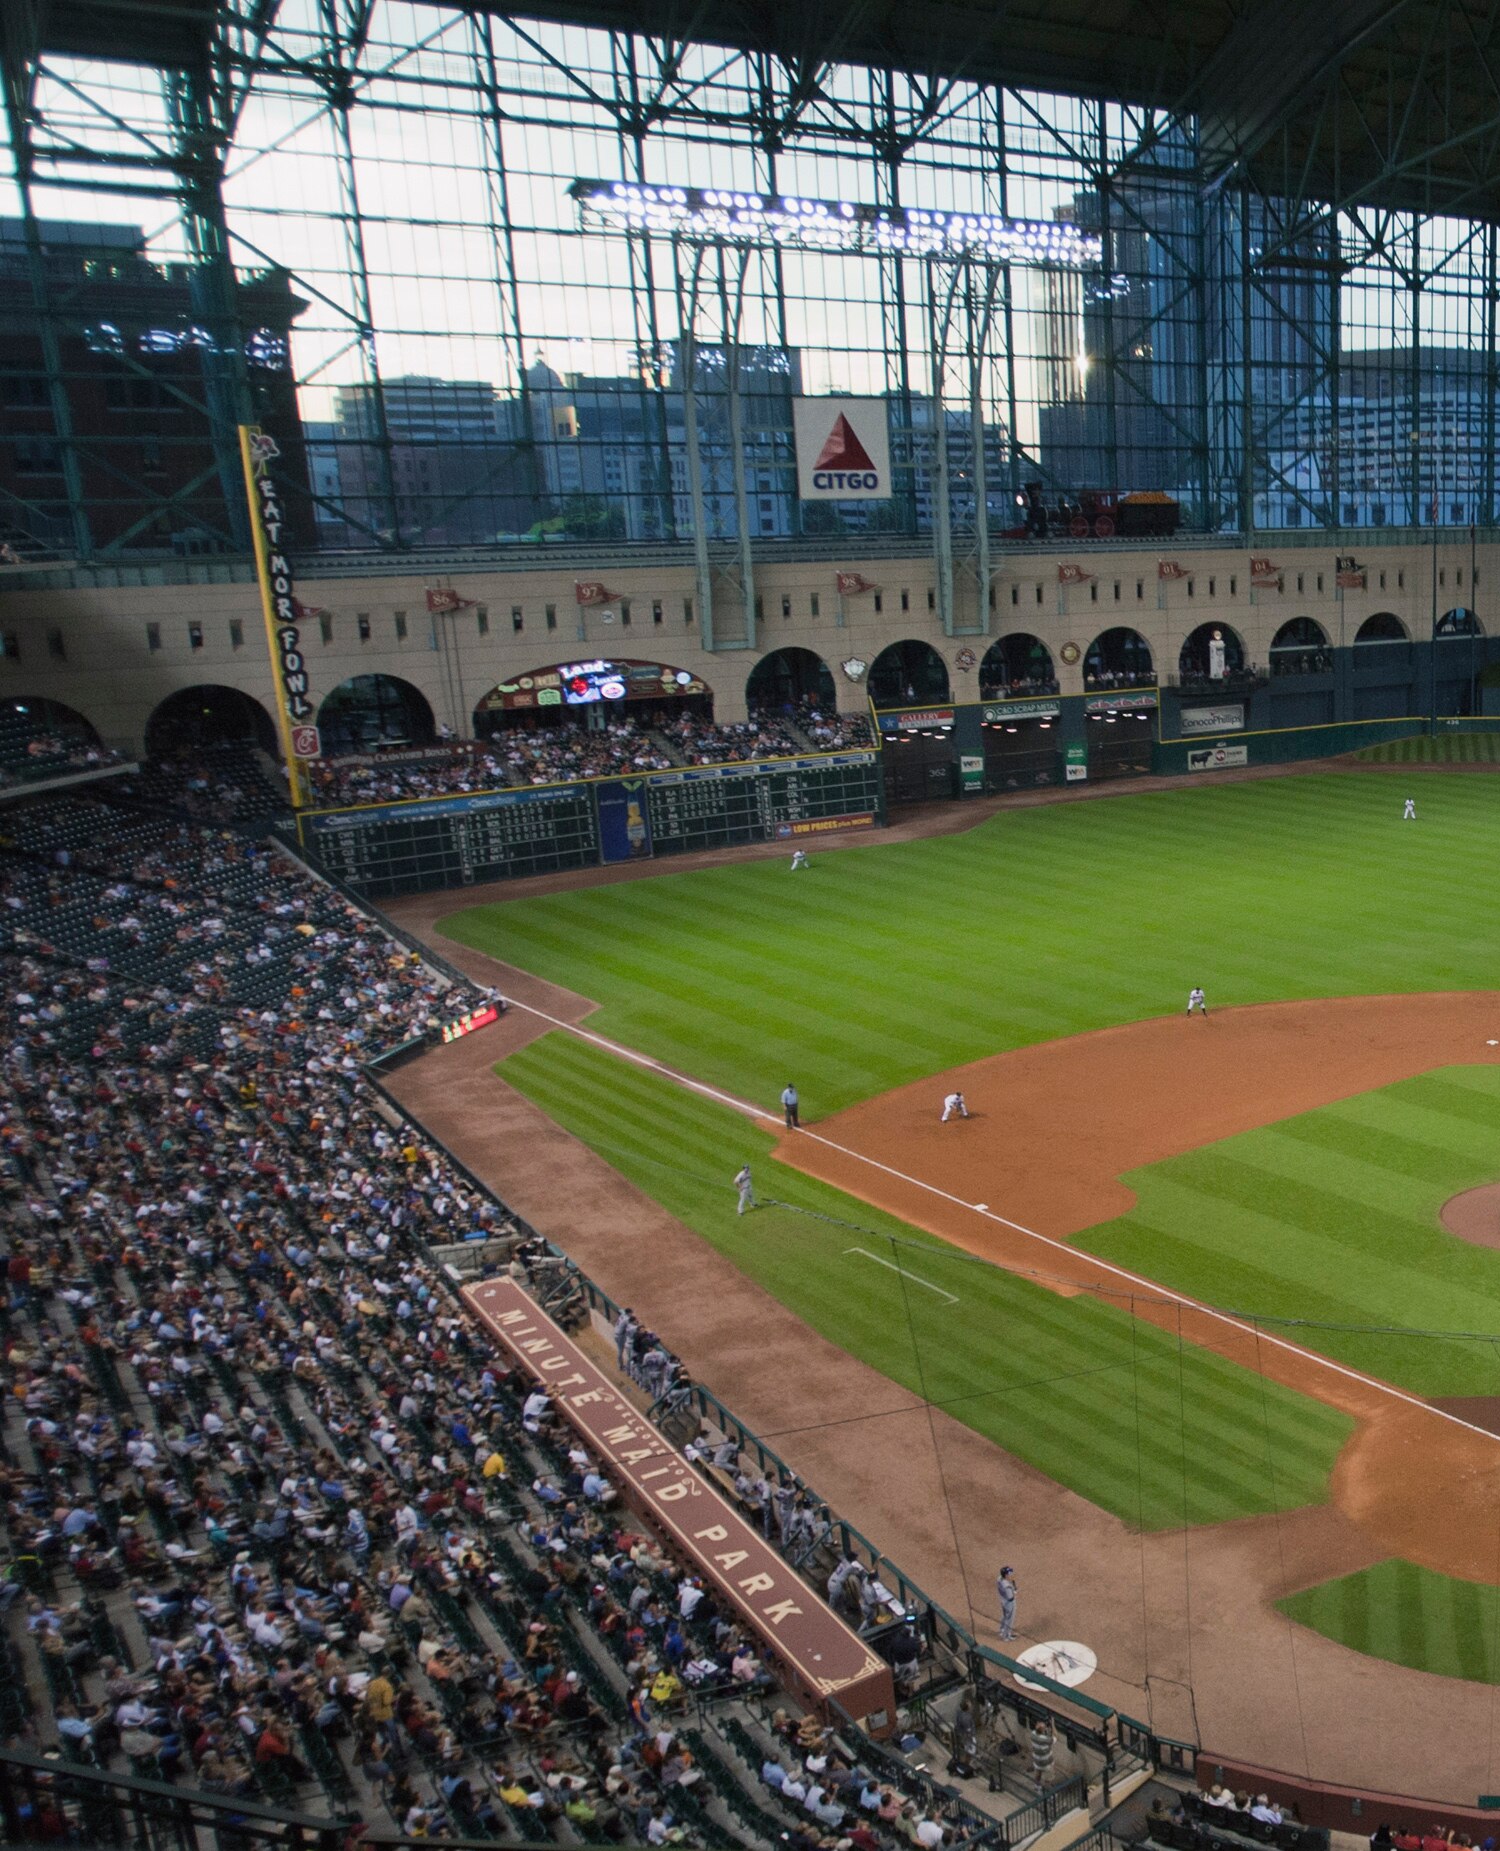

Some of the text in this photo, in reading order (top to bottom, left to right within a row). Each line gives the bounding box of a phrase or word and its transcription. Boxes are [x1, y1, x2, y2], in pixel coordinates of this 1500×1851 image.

[813, 472, 879, 490] CITGO
[260, 479, 282, 543] EAT
[1063, 566, 1077, 579] 99
[271, 555, 293, 620] MOR
[842, 575, 857, 589] 98
[581, 585, 599, 600] 97
[433, 593, 450, 608] 86
[282, 631, 309, 716] FOWL
[901, 712, 939, 722] GALLERY
[1182, 712, 1242, 728] ConocoPhillips
[929, 769, 946, 777] 362
[793, 824, 809, 833] LOW
[811, 821, 837, 831] PRICES
[614, 1404, 684, 1475] WELCOME TO
[497, 1308, 803, 1625] MINUTE MAID PARK
